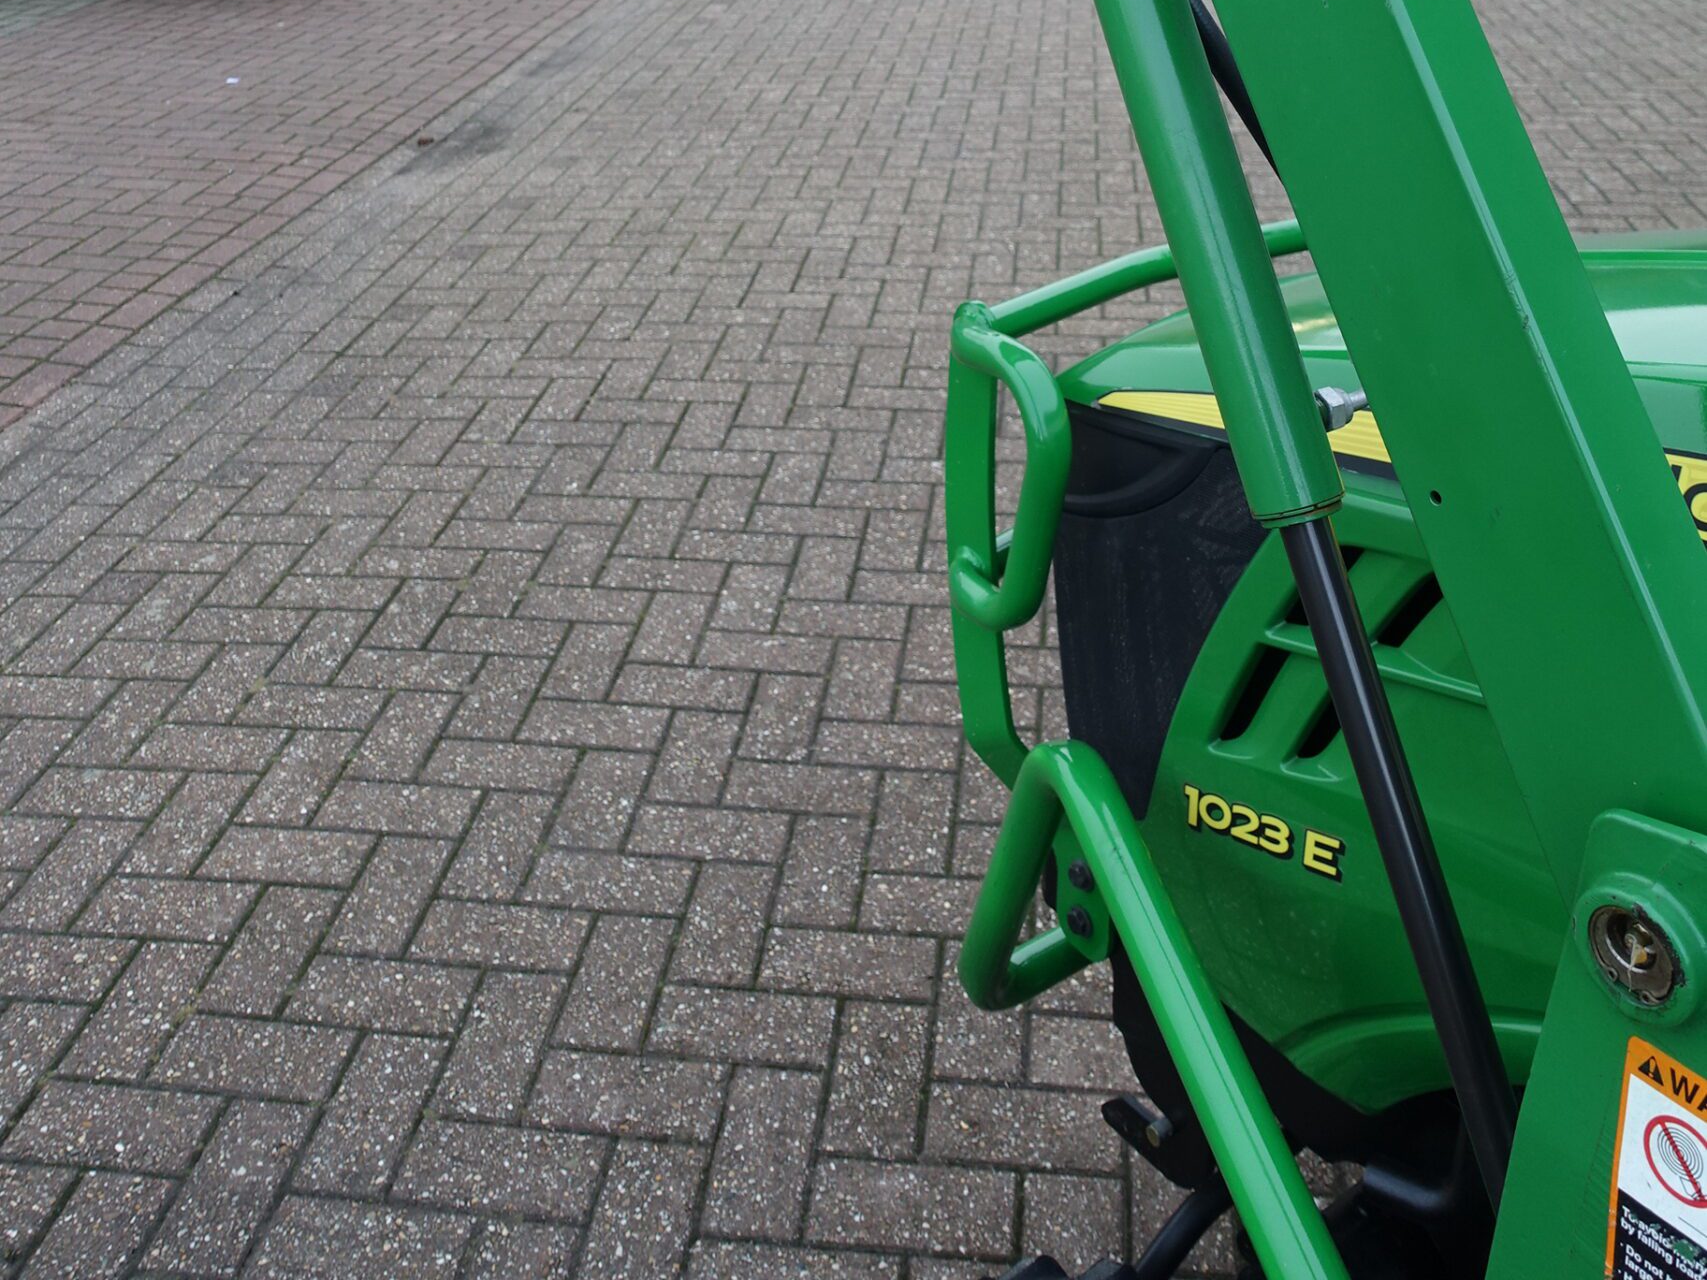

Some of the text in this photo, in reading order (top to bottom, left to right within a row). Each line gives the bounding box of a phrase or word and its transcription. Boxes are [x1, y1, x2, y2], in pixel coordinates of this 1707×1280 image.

[1184, 783, 1346, 883] 1023 E
[1621, 1217, 1635, 1235] by
[1637, 1230, 1673, 1265] falling
[1626, 1244, 1642, 1263] Do
[1644, 1261, 1664, 1280] not
